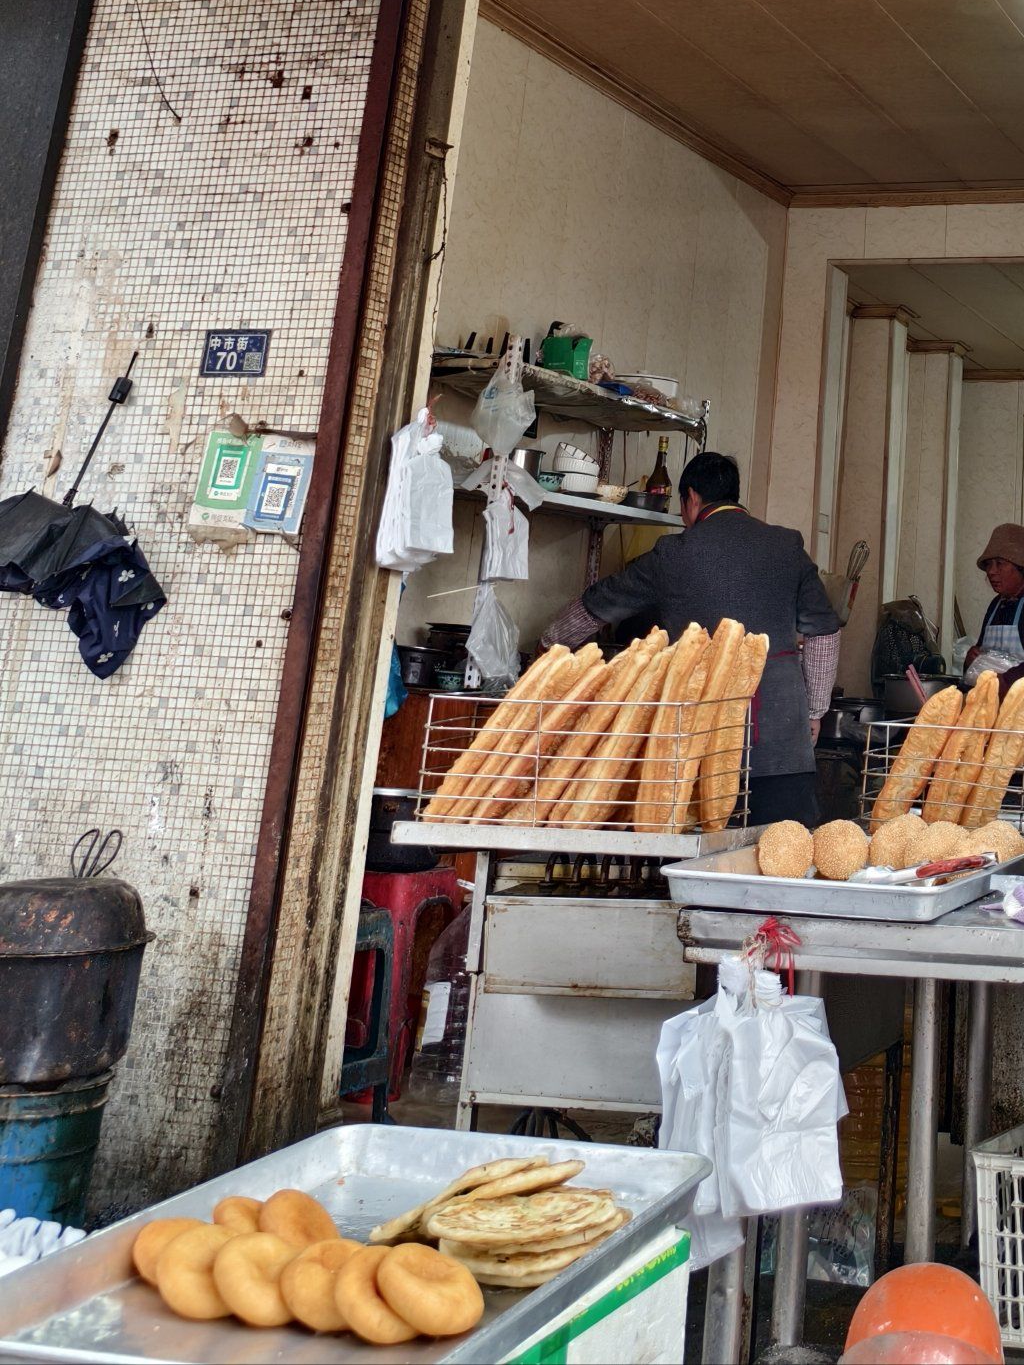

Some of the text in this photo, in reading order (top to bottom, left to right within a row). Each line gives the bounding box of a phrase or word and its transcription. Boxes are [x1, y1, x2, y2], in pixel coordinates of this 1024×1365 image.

[209, 336, 249, 351] 中市街
[215, 351, 238, 371] 70
